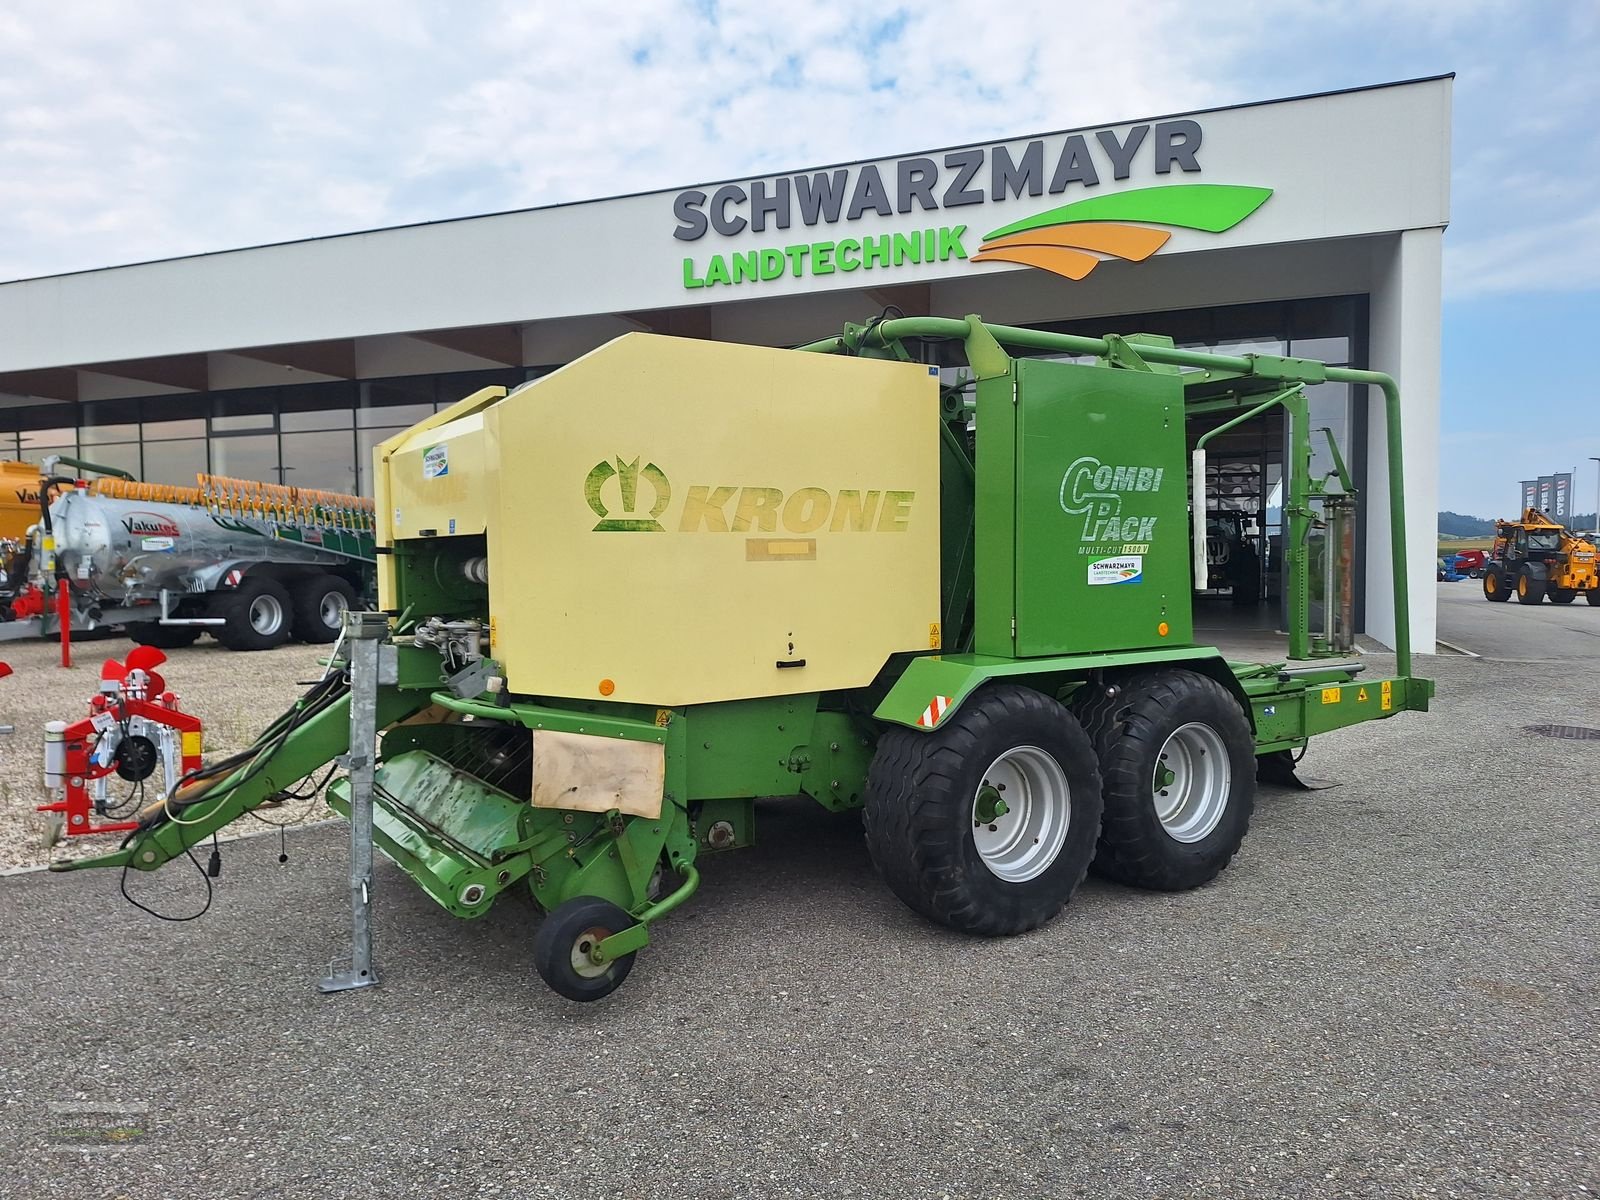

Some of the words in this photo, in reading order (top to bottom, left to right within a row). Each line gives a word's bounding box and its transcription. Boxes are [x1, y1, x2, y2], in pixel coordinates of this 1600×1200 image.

[672, 118, 1204, 242] SCHWARZMAYR
[683, 225, 969, 289] LANDTECHNIK
[678, 485, 916, 533] KRONE
[1060, 456, 1164, 514] COMBI
[121, 516, 180, 535] Vakutec
[1081, 493, 1157, 542] PACK
[1078, 546, 1122, 555] MULTI-CUT
[1093, 562, 1135, 570] SCHWARZMAYR
